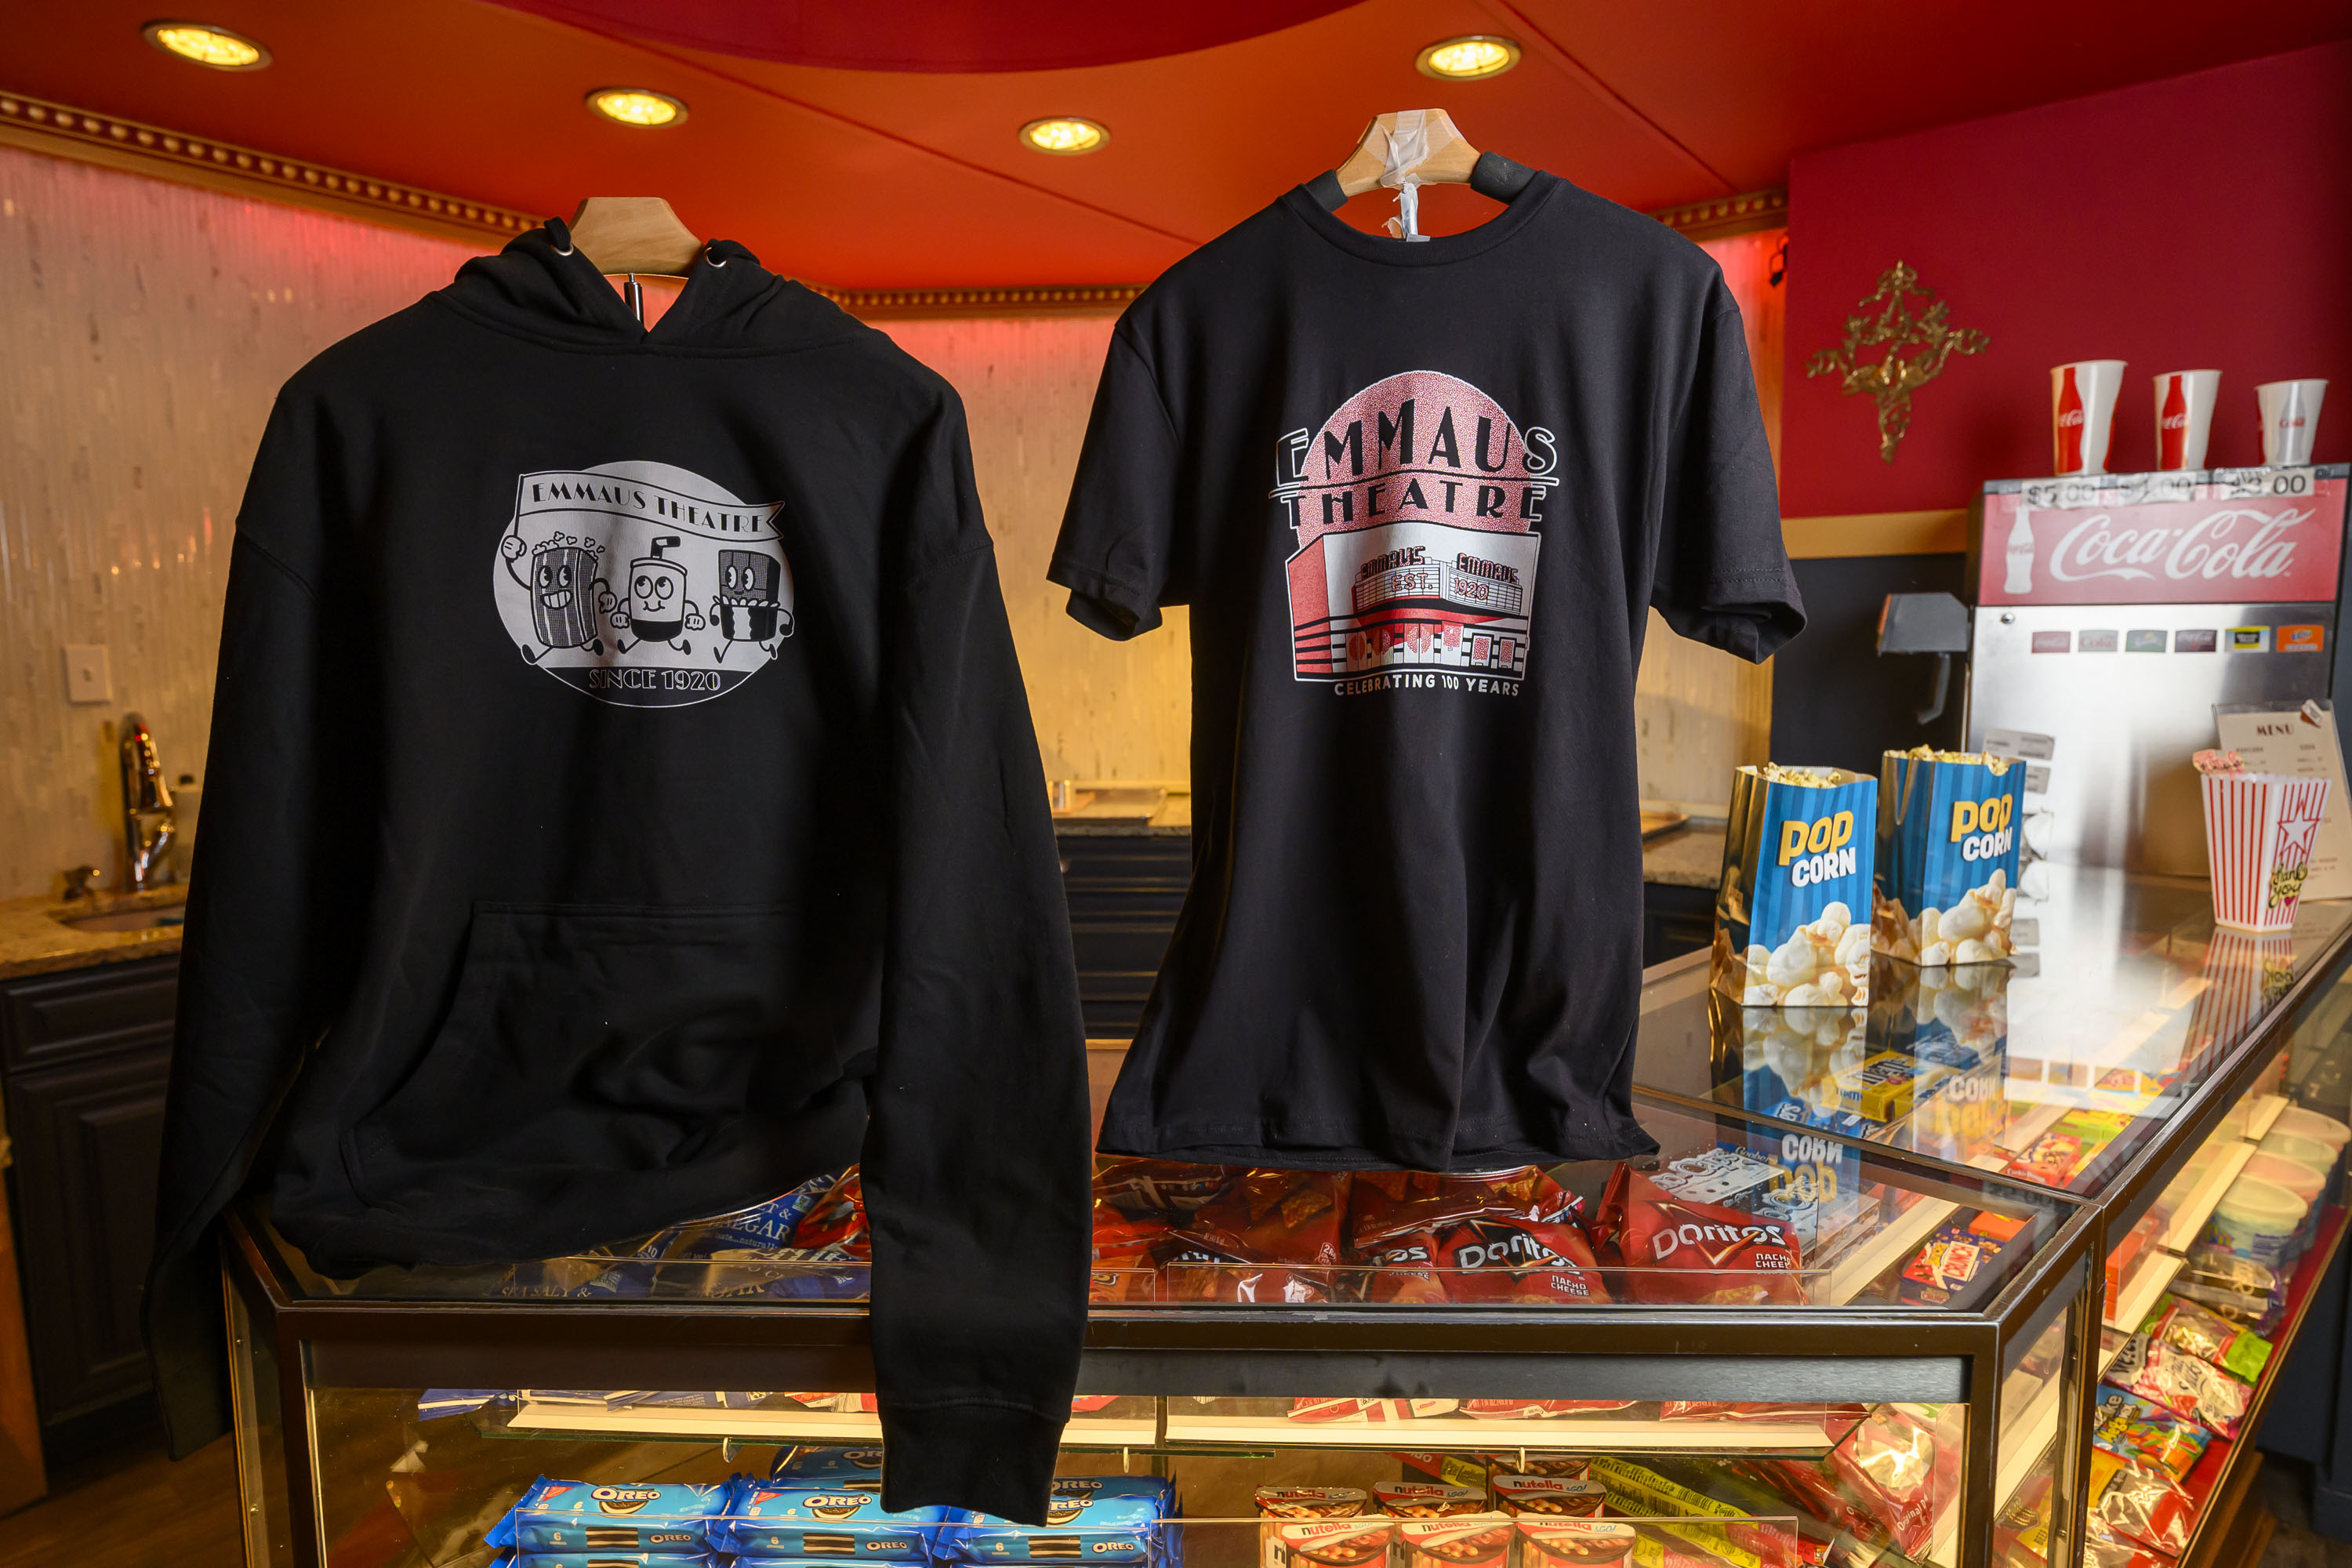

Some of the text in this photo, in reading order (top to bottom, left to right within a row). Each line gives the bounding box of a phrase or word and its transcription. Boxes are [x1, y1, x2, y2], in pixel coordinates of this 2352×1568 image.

[1276, 397, 1557, 486] EMMAUS
[532, 481, 764, 534] EMMAUS THEATRE
[1280, 477, 1547, 531] THEATRE
[2049, 506, 2316, 583] Coca-Cola
[1360, 546, 1427, 579] EMMAUS
[1457, 552, 1519, 584] EMMAUS
[1391, 573, 1433, 593] EST.
[1454, 577, 1490, 601] 1920
[589, 668, 721, 691] SINCE 1920
[1334, 674, 1519, 697] CELEBRATING 100 YEARS
[2256, 722, 2295, 737] MENU
[1950, 793, 2013, 843] POP
[1778, 810, 1854, 866] POP
[1962, 826, 2013, 862] CORN
[1791, 847, 1857, 888] CORN
[1652, 1224, 1787, 1260] Doritos
[1460, 1233, 1581, 1274] Doritos
[1551, 1275, 1586, 1290] NACHO
[1551, 1281, 1590, 1296] CHEESE
[842, 1450, 883, 1461] OR
[591, 1487, 661, 1501] OREO
[1395, 1486, 1442, 1498] nutella
[1513, 1478, 1563, 1491] nutella
[574, 1501, 584, 1509] 6
[803, 1496, 872, 1508] OREO
[1050, 1498, 1094, 1512] REO
[1897, 1503, 1922, 1531] Original
[554, 1532, 562, 1541] 6
[650, 1534, 691, 1544] OREO
[1301, 1523, 1352, 1537] nutella
[866, 1541, 908, 1552] OREO
[996, 1542, 1004, 1551] 6
[1092, 1542, 1134, 1553] OREO
